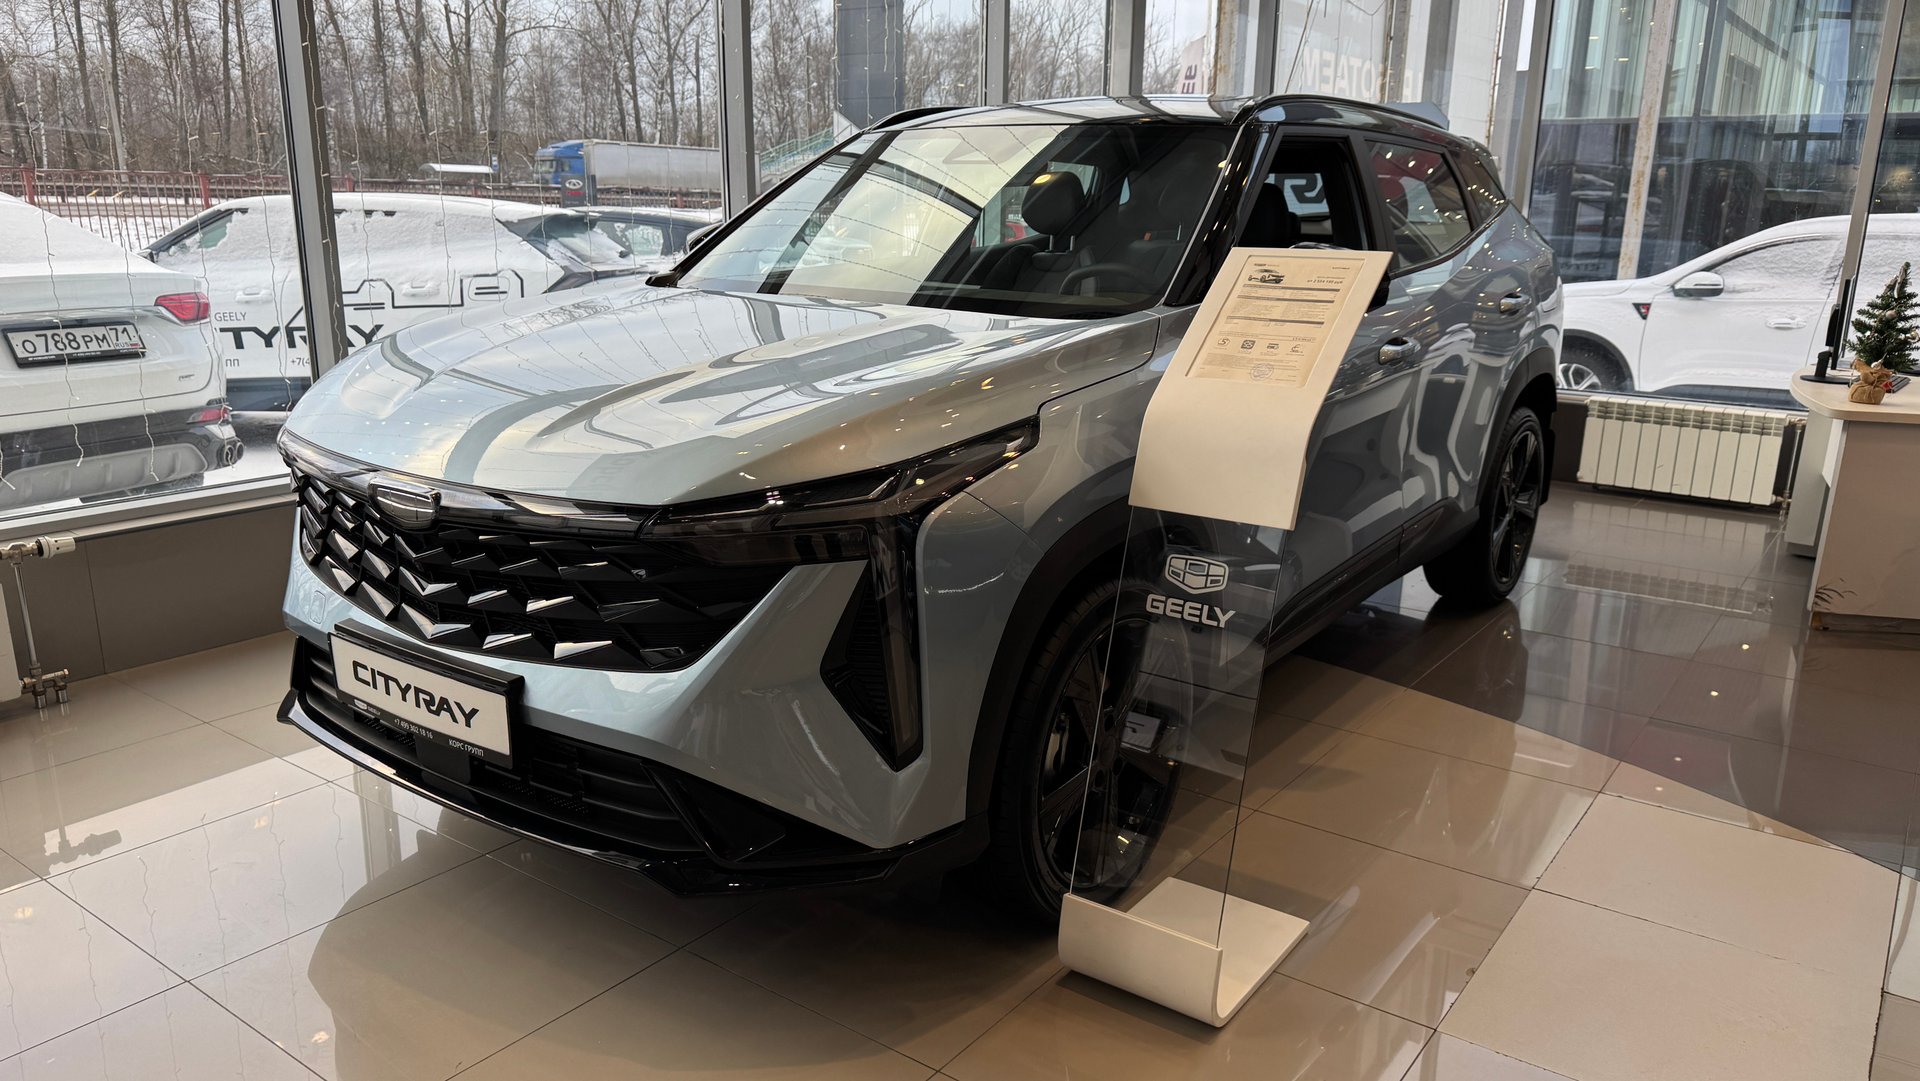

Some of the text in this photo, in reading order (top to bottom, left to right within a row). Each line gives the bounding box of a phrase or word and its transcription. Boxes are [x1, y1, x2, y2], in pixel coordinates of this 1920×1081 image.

[214, 311, 247, 322] GEELY
[1145, 593, 1236, 629] GEELY
[352, 660, 480, 729] CITYRAY
[448, 738, 484, 758] КОРС ГРУПП
